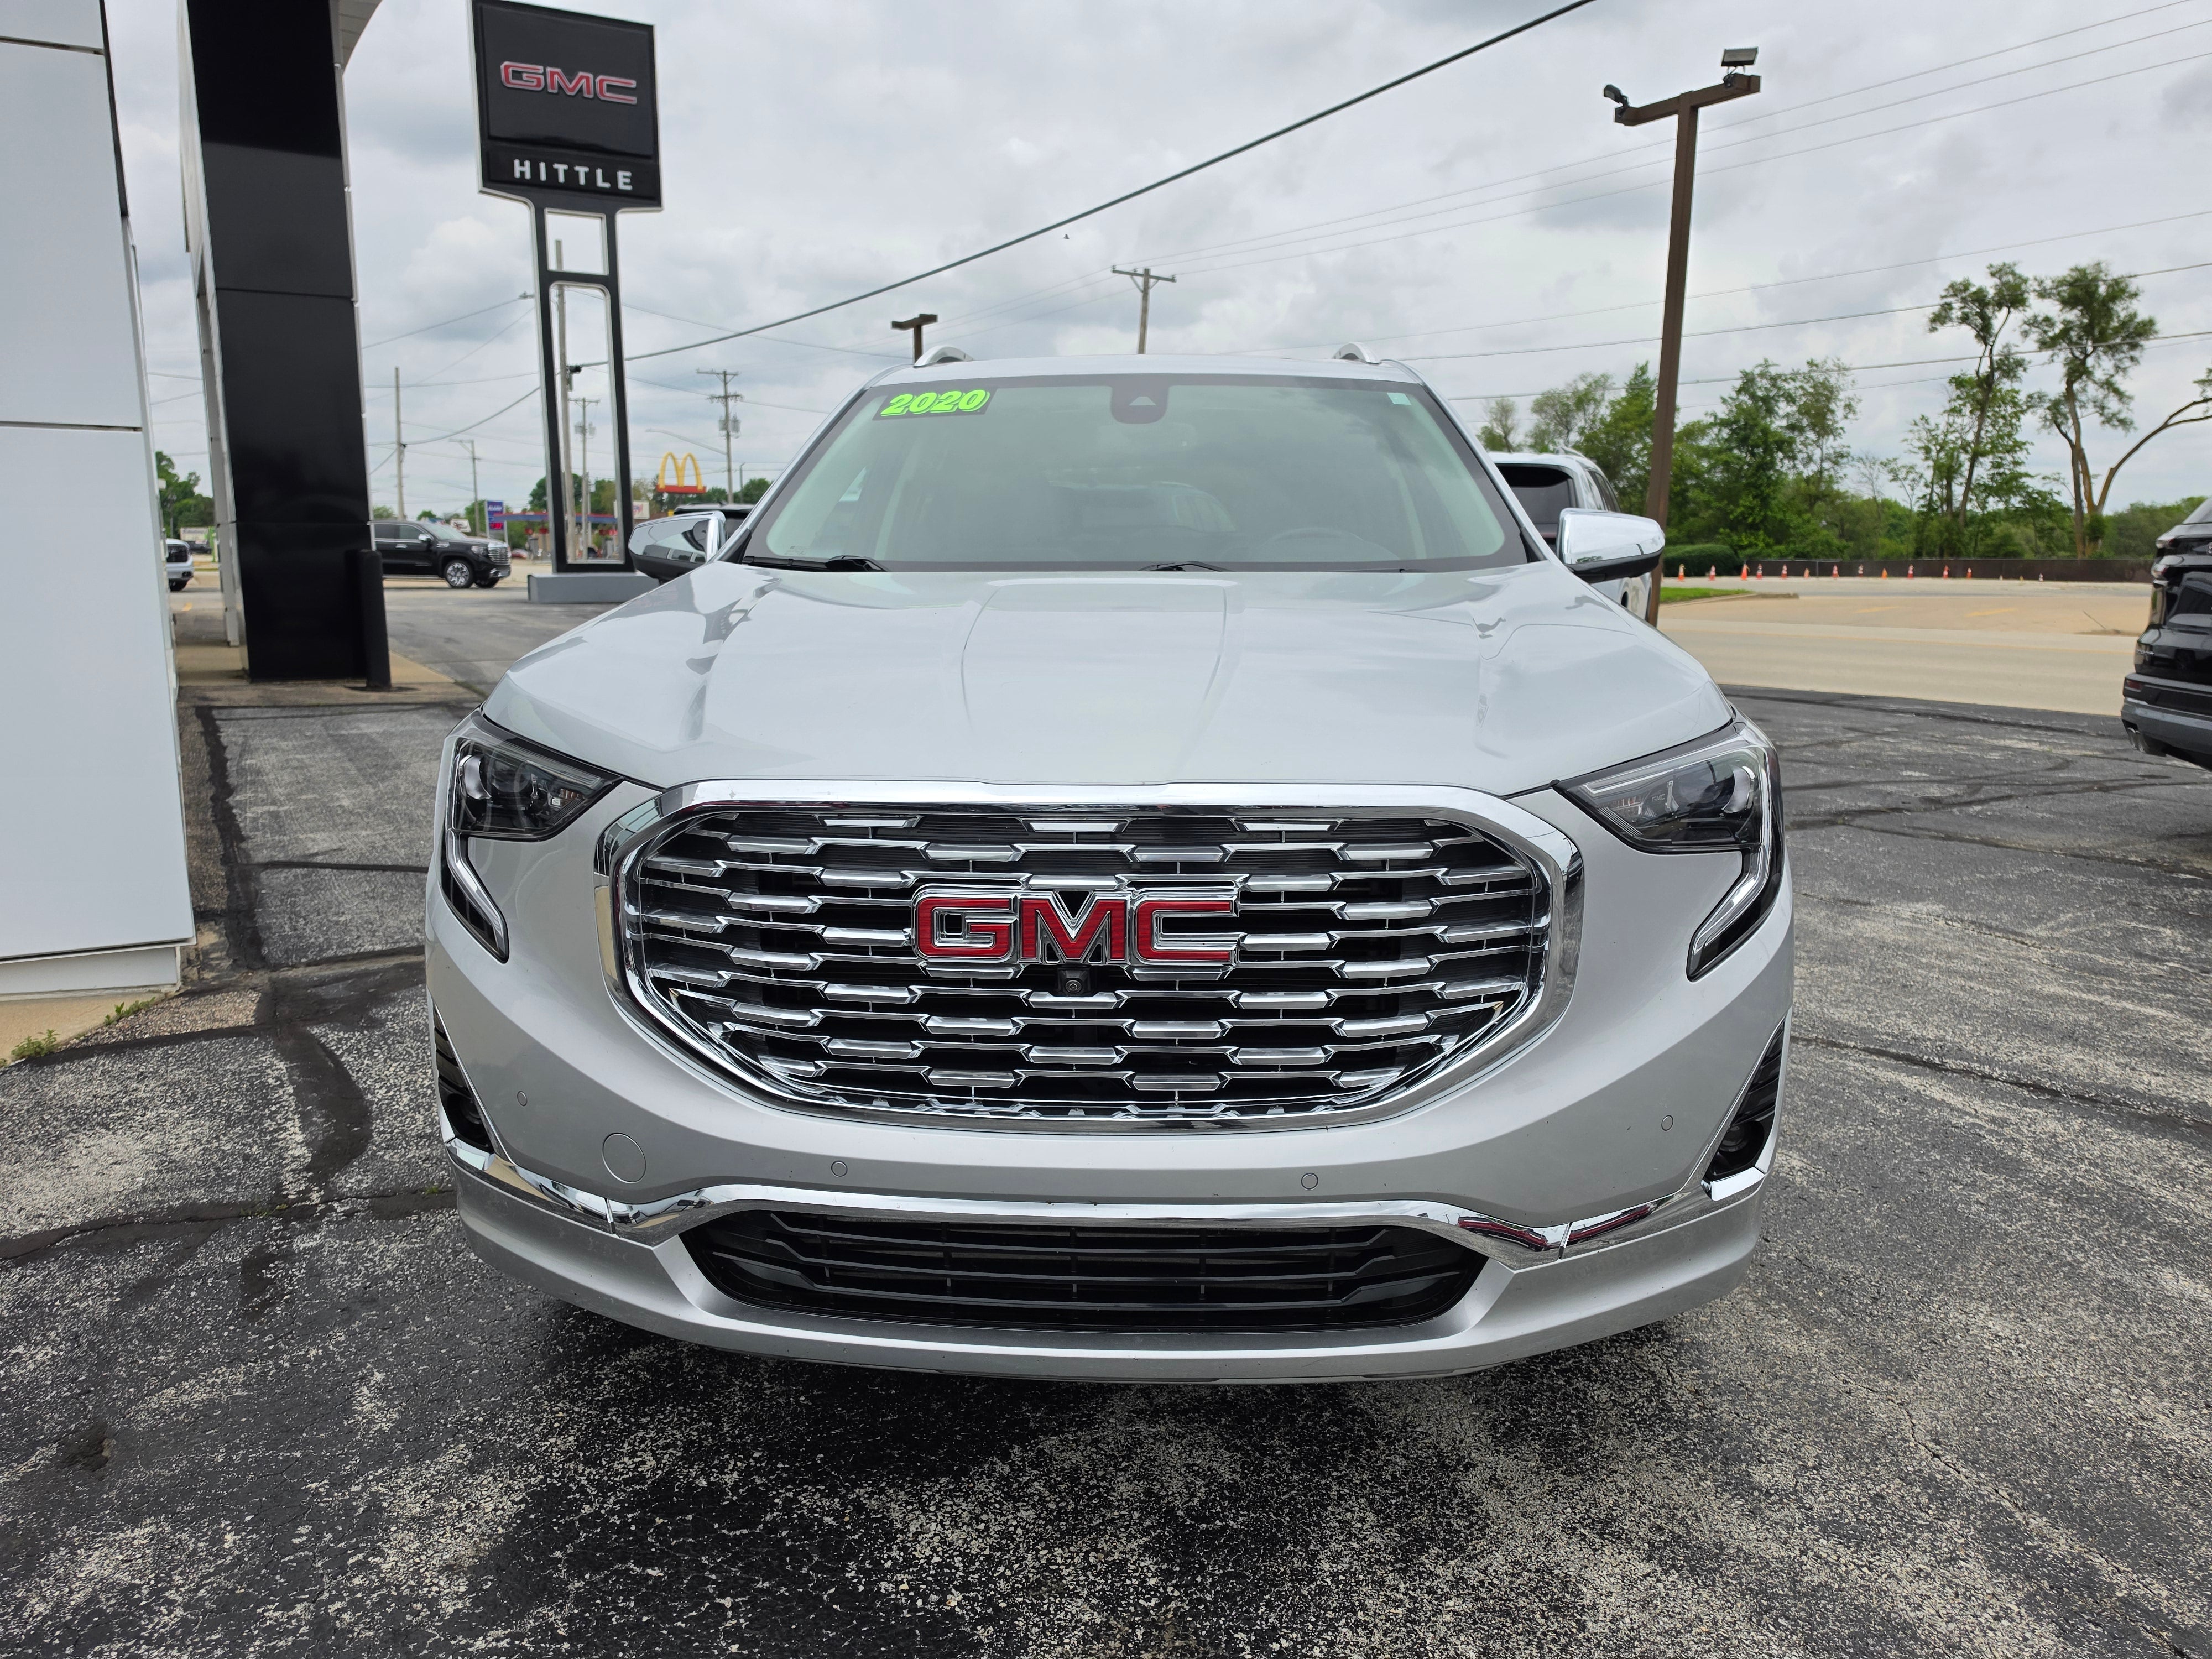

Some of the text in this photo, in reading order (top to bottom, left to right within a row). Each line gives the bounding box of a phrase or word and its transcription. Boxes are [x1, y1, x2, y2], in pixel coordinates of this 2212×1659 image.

[500, 61, 637, 105] GMC
[513, 159, 633, 191] HITTLE
[880, 389, 990, 416] 2020
[912, 888, 1239, 965] GMC
